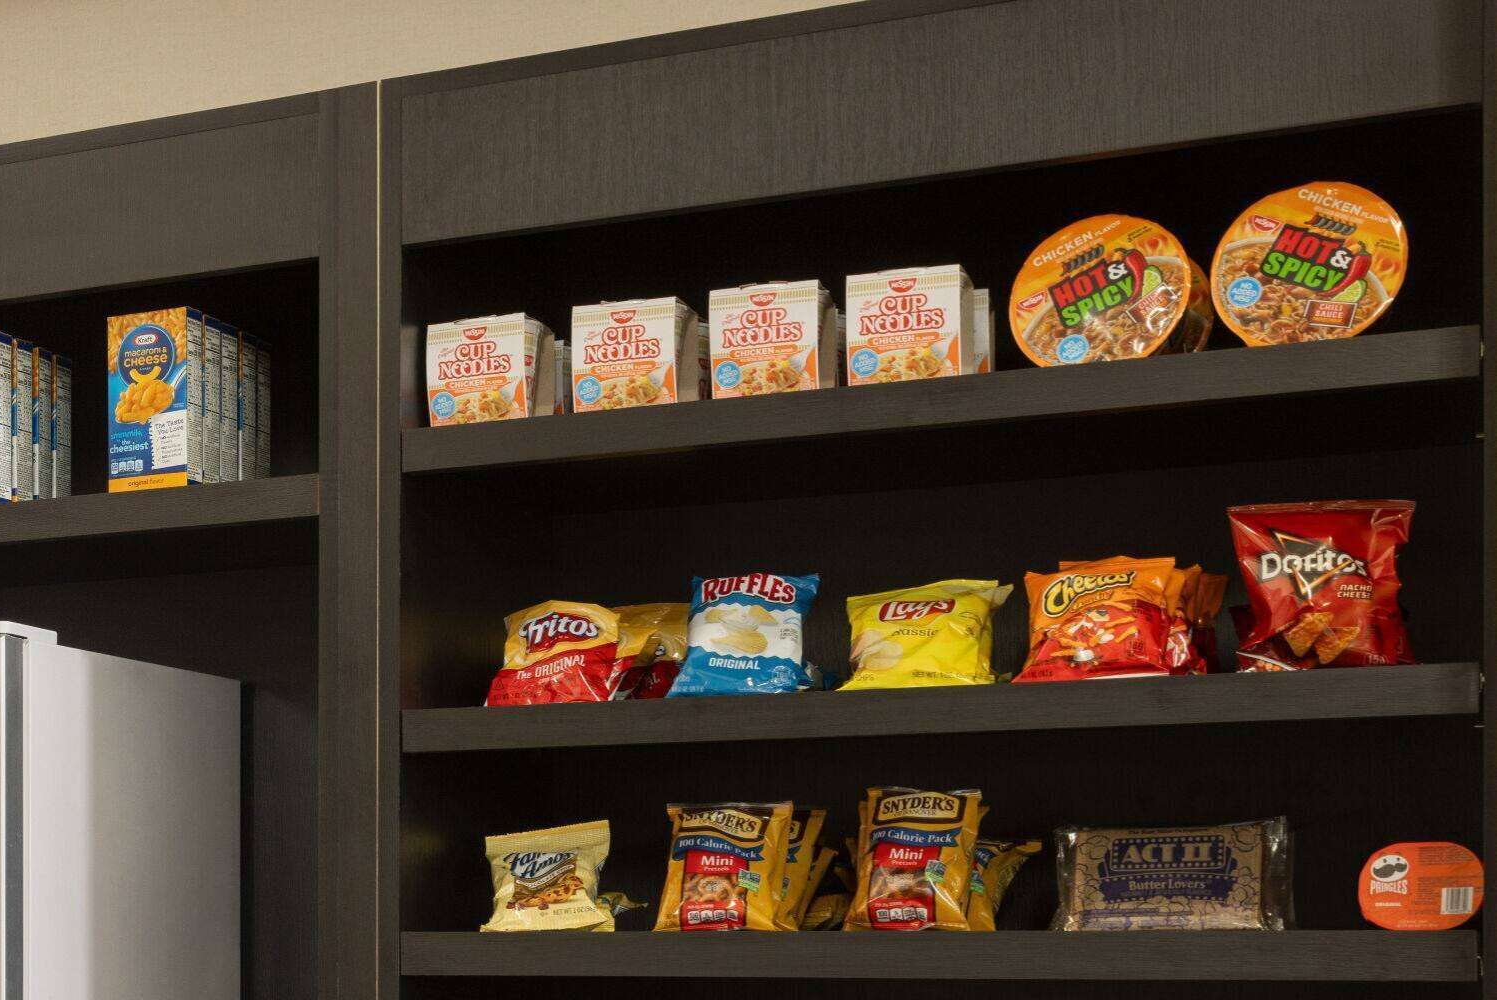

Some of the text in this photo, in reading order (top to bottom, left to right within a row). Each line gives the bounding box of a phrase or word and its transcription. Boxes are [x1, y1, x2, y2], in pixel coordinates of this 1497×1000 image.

[1298, 188, 1363, 216] CHICKEN
[1033, 231, 1093, 267] CHICKEN
[1276, 228, 1352, 270] HOT &
[1262, 252, 1346, 291] SPICY
[1054, 263, 1127, 308] HOT &
[879, 293, 927, 316] CUP
[1061, 276, 1133, 327] SPICY
[1319, 303, 1343, 312] CHILI
[740, 308, 787, 329] CUP
[859, 308, 945, 335] NOODLES
[1315, 310, 1344, 319] SAUCE
[601, 325, 646, 346] CUP
[722, 322, 803, 348] NOODLES
[873, 335, 915, 345] CHICKEN
[124, 347, 162, 358] macaroni
[455, 341, 496, 361] CUP
[583, 338, 661, 364] NOODLES
[734, 348, 775, 357] CHICKEN
[438, 354, 511, 380] NOODLES
[596, 364, 634, 373] CHICKEN
[450, 379, 486, 389] CHICKEN
[109, 442, 149, 454] cheesiest
[128, 479, 149, 487] original
[1260, 546, 1368, 580] Doritos
[701, 572, 796, 604] RUFFLES
[519, 613, 600, 652] Fritos
[516, 669, 533, 680] The
[534, 654, 586, 677] ORIGINAL
[708, 657, 761, 671] ORIGINAL
[881, 796, 954, 815] SNYDER'S
[887, 829, 925, 843] Calorie
[927, 834, 953, 844] Pack
[678, 838, 757, 858] 100 Calorie Pack
[889, 848, 923, 860] Mini
[1122, 843, 1213, 864] ACT II
[701, 855, 734, 866] Mini
[1129, 878, 1207, 891] Butter Lovers
[1370, 879, 1408, 895] PRINGLES
